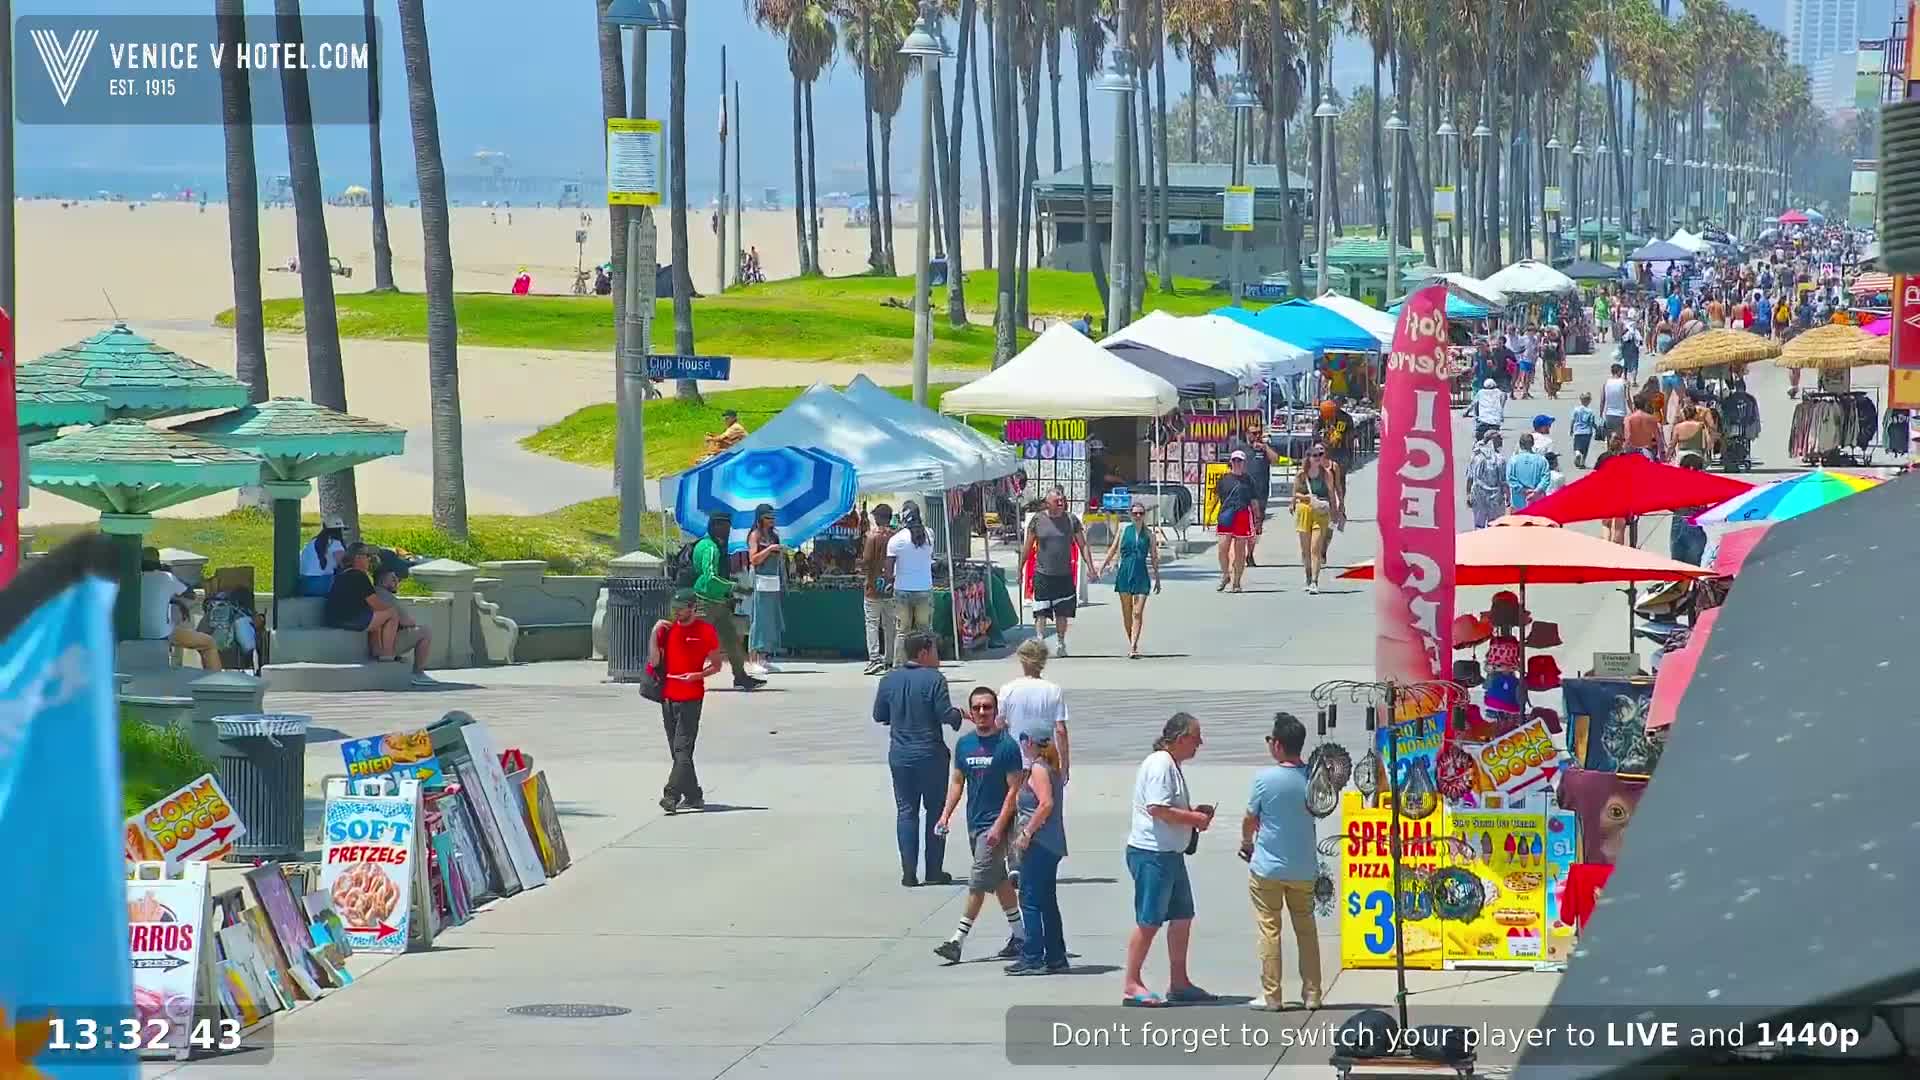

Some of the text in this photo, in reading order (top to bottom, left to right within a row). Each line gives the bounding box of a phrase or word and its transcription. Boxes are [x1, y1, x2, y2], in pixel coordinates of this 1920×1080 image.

[649, 356, 712, 370] Club House
[1045, 418, 1085, 440] TATTOO
[1481, 720, 1549, 766] CORN
[349, 755, 393, 777] FRIED
[1489, 741, 1558, 786] DOGS
[145, 780, 218, 832] CORN
[157, 800, 231, 851] DOGS
[329, 818, 411, 844] SOFT
[328, 846, 408, 866] PRETZELS
[1348, 863, 1391, 878] PIZZA
